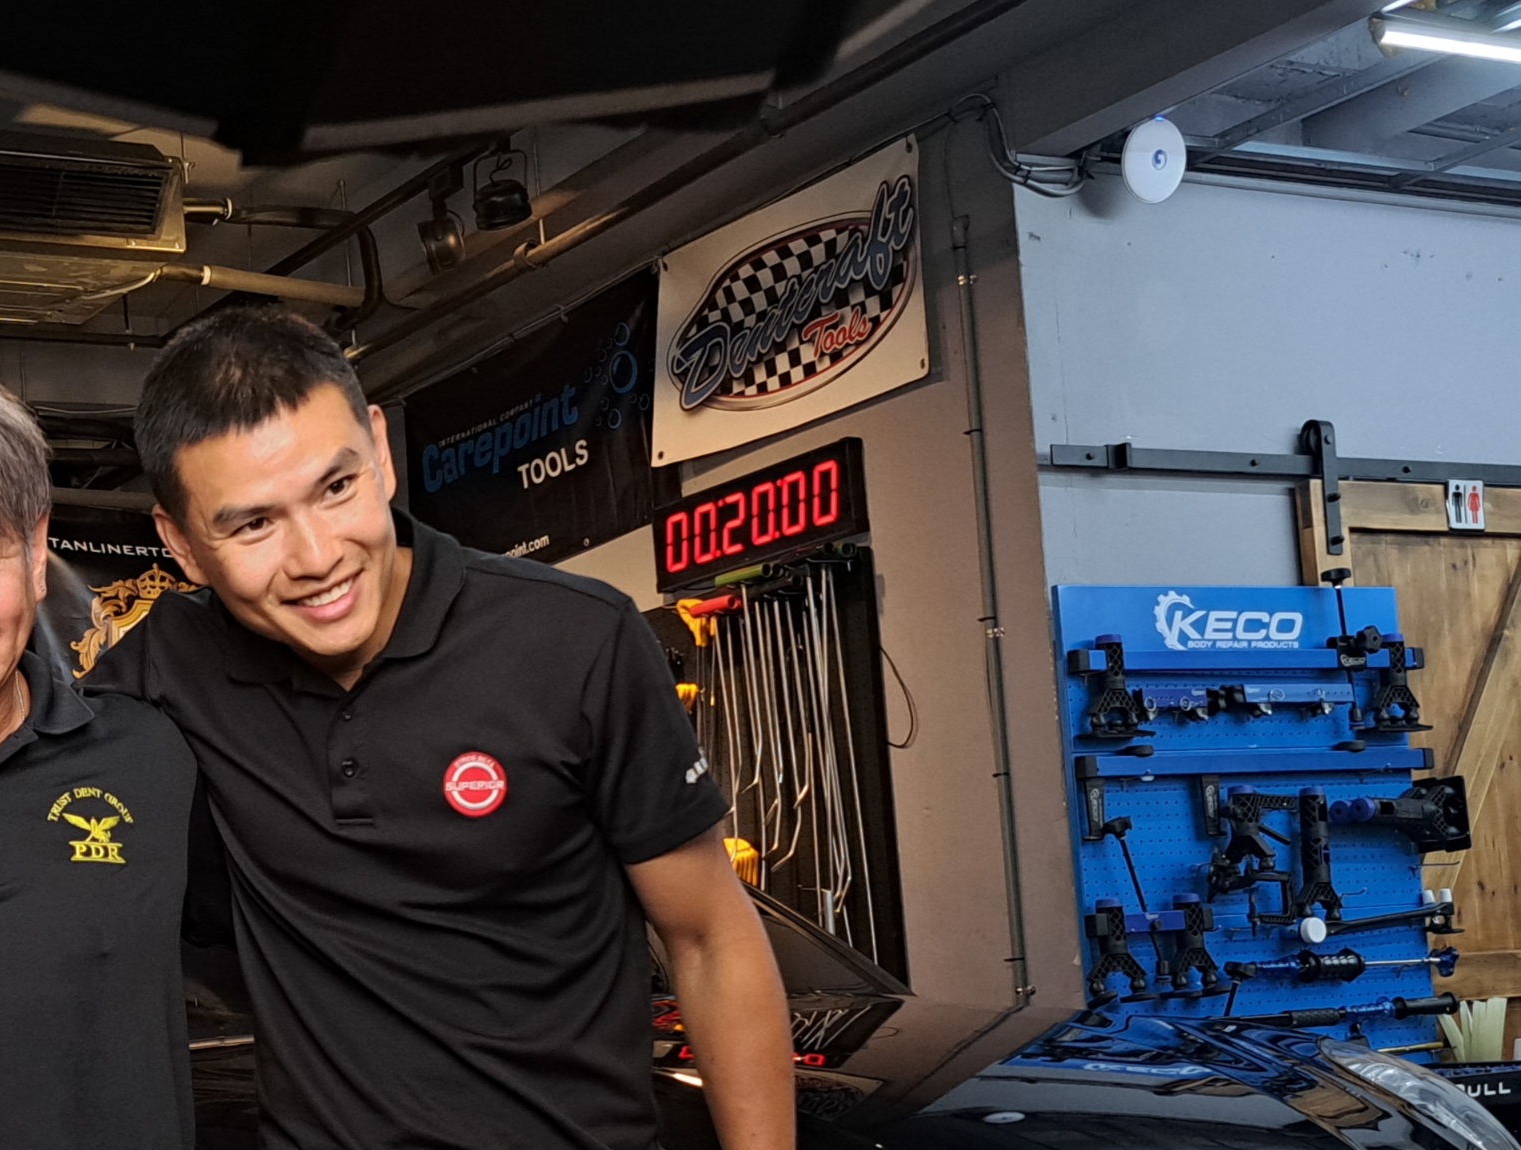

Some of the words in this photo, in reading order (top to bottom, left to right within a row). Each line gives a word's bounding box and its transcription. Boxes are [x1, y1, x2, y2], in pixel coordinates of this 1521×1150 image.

[673, 175, 915, 411] Dentcraft
[801, 306, 871, 359] Tools
[422, 384, 579, 493] Carepoint
[438, 418, 496, 448] INTERNATIONAL
[499, 399, 534, 422] COMPANY
[517, 439, 589, 489] TOOLS
[1171, 611, 1304, 641] KECO
[1187, 640, 1212, 649] BODY
[1215, 640, 1248, 649] REPAIR
[1251, 641, 1299, 649] PRODUCTS
[47, 792, 72, 822] TRUST
[73, 787, 102, 799] DENT
[104, 792, 134, 824] GROUP
[445, 780, 505, 792] SUPERIOR
[75, 844, 120, 860] PDR
